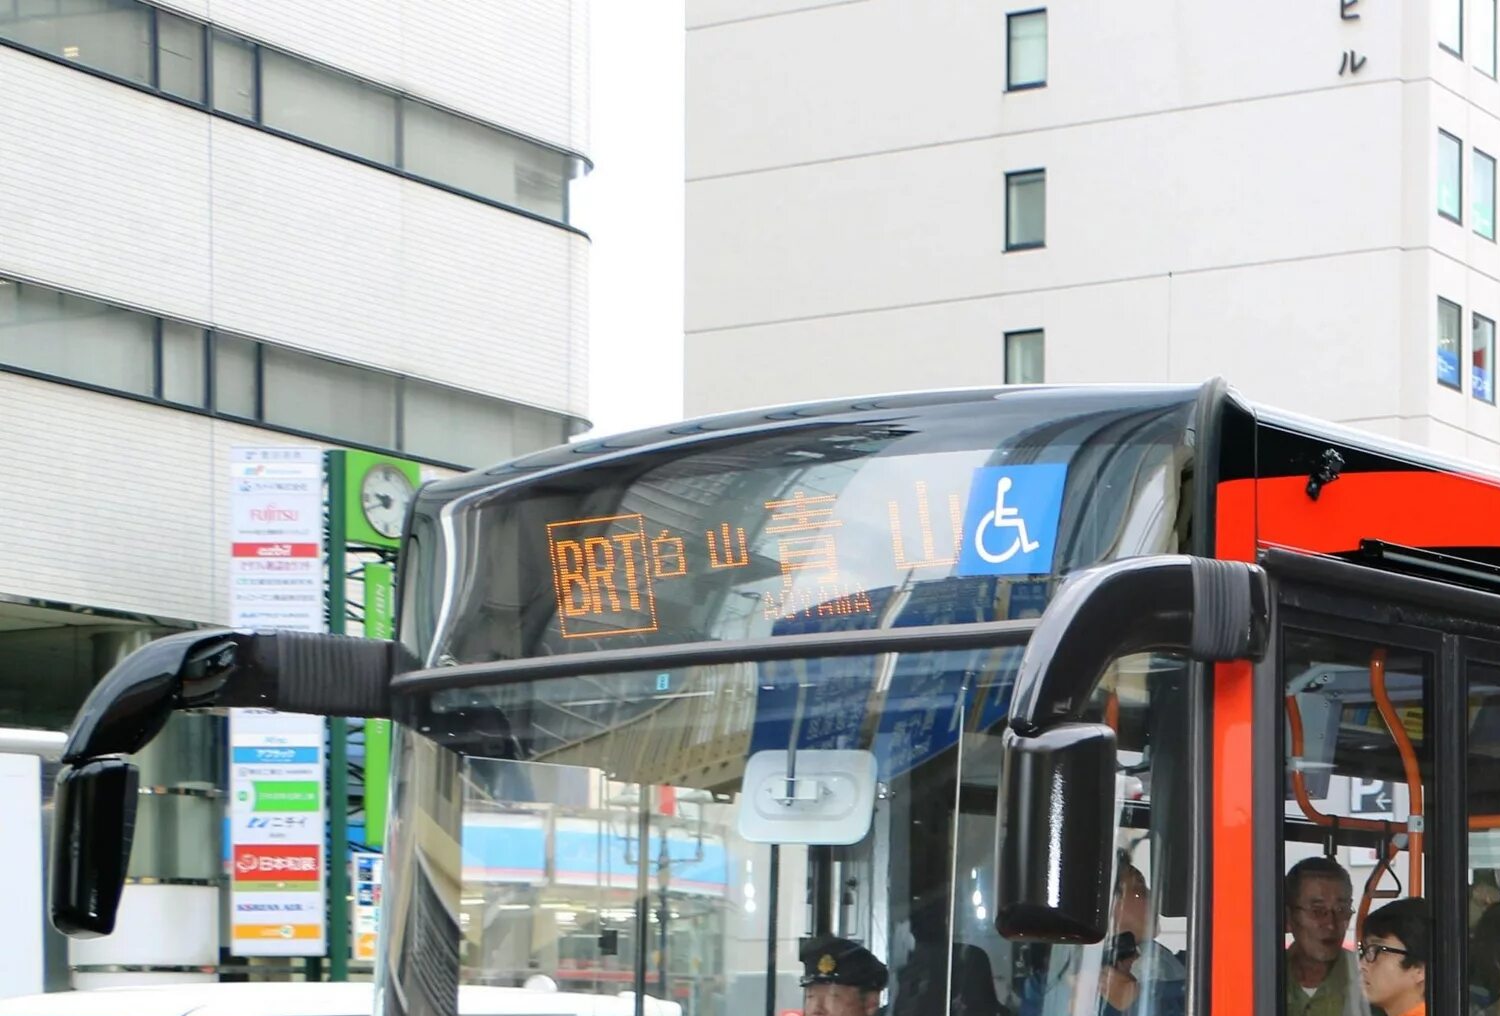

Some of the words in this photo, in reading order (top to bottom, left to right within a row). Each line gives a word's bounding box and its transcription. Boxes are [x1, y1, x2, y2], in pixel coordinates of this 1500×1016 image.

[250, 503, 299, 524] FUJITSU
[764, 480, 964, 583] 青山
[556, 533, 642, 616] BRT
[763, 580, 872, 621] AOYAMA
[258, 856, 316, 871] 日本和装
